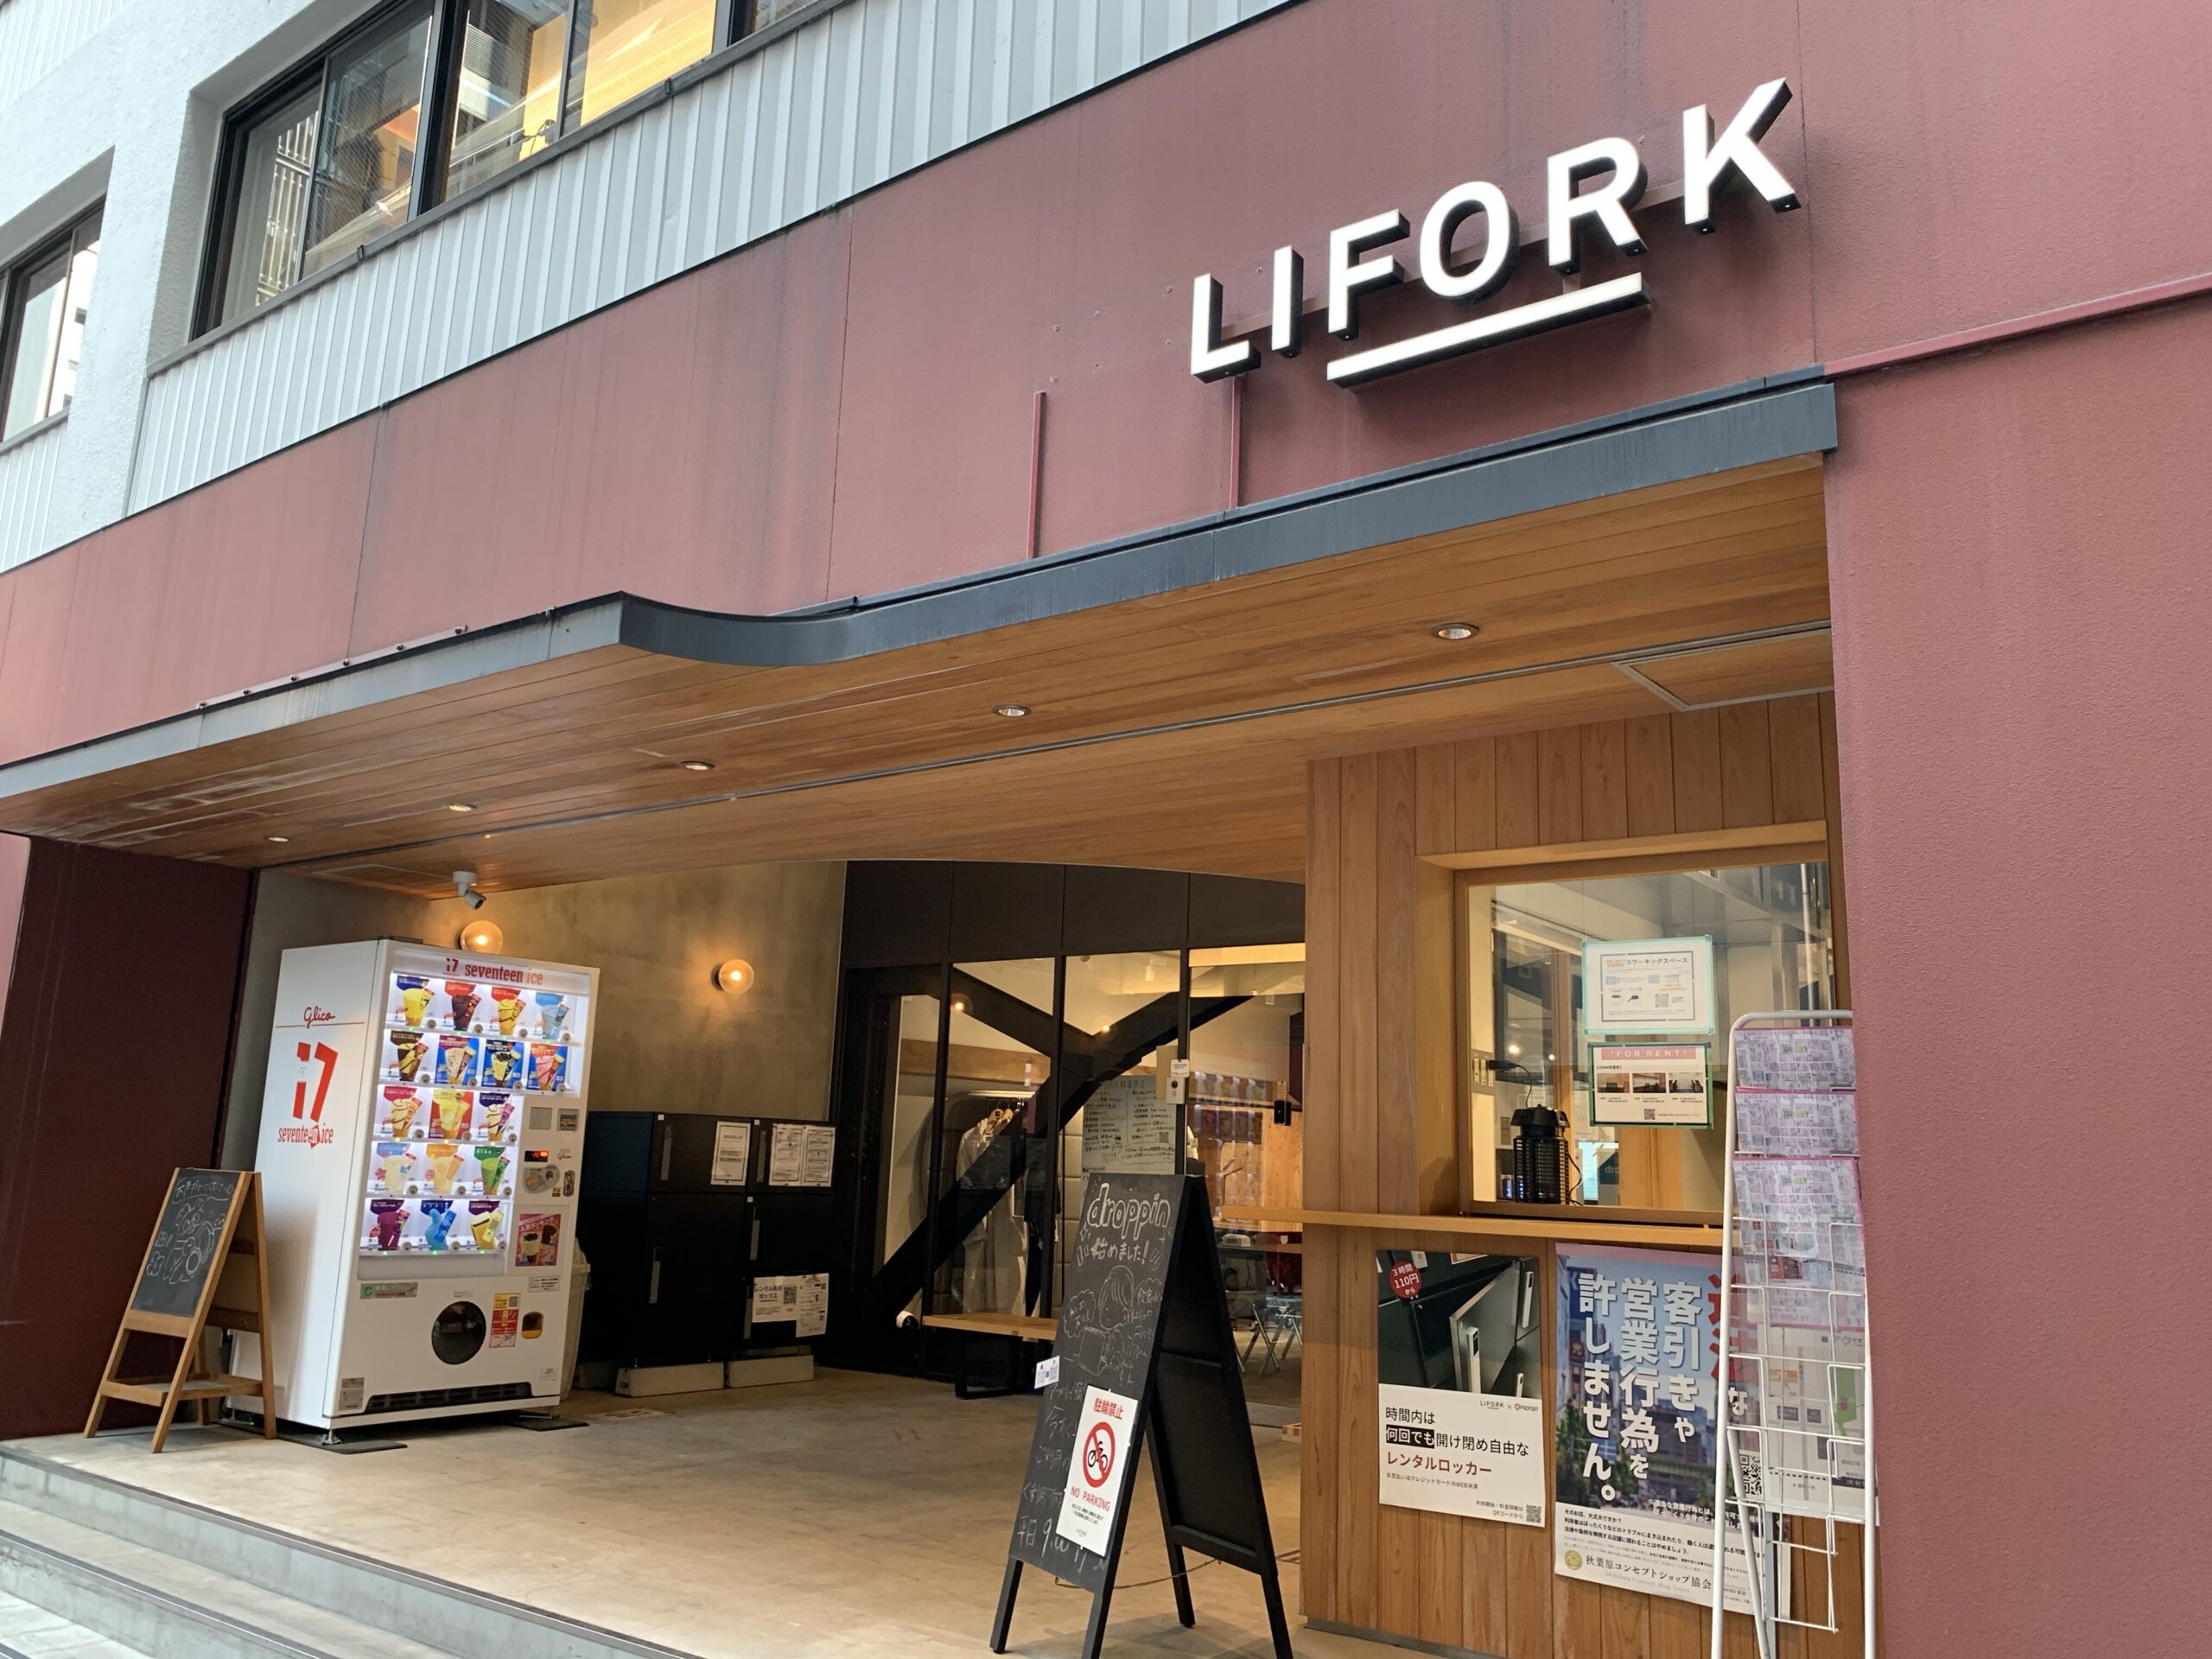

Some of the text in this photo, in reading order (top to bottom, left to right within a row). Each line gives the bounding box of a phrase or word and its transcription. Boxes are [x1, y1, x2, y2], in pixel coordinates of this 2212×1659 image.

[1190, 77, 1799, 380] LIFORK
[465, 963, 524, 983] seventeen
[525, 968, 544, 985] ice
[303, 1005, 336, 1028] Glico
[277, 1123, 334, 1146] seventeen ice
[1086, 1182, 1172, 1241] droppin
[1394, 1273, 1420, 1289] 110円
[1404, 1287, 1416, 1295] から
[1662, 1281, 1702, 1444] 客引きや
[1578, 1272, 1618, 1502] 許しません。
[1619, 1277, 1660, 1481] 営業行為を
[1092, 1397, 1124, 1421] 駐輪禁止
[1385, 1407, 1435, 1425] 時間内は
[1479, 1400, 1504, 1409] LIFORK
[1385, 1427, 1529, 1457] 何回でも開け閉め自由な
[1387, 1452, 1493, 1477] レンタルロッカー
[1070, 1485, 1081, 1498] NO
[1082, 1491, 1111, 1512] PARKING
[1586, 1554, 1713, 1591] 秋葉原コンセプトショップ協会
